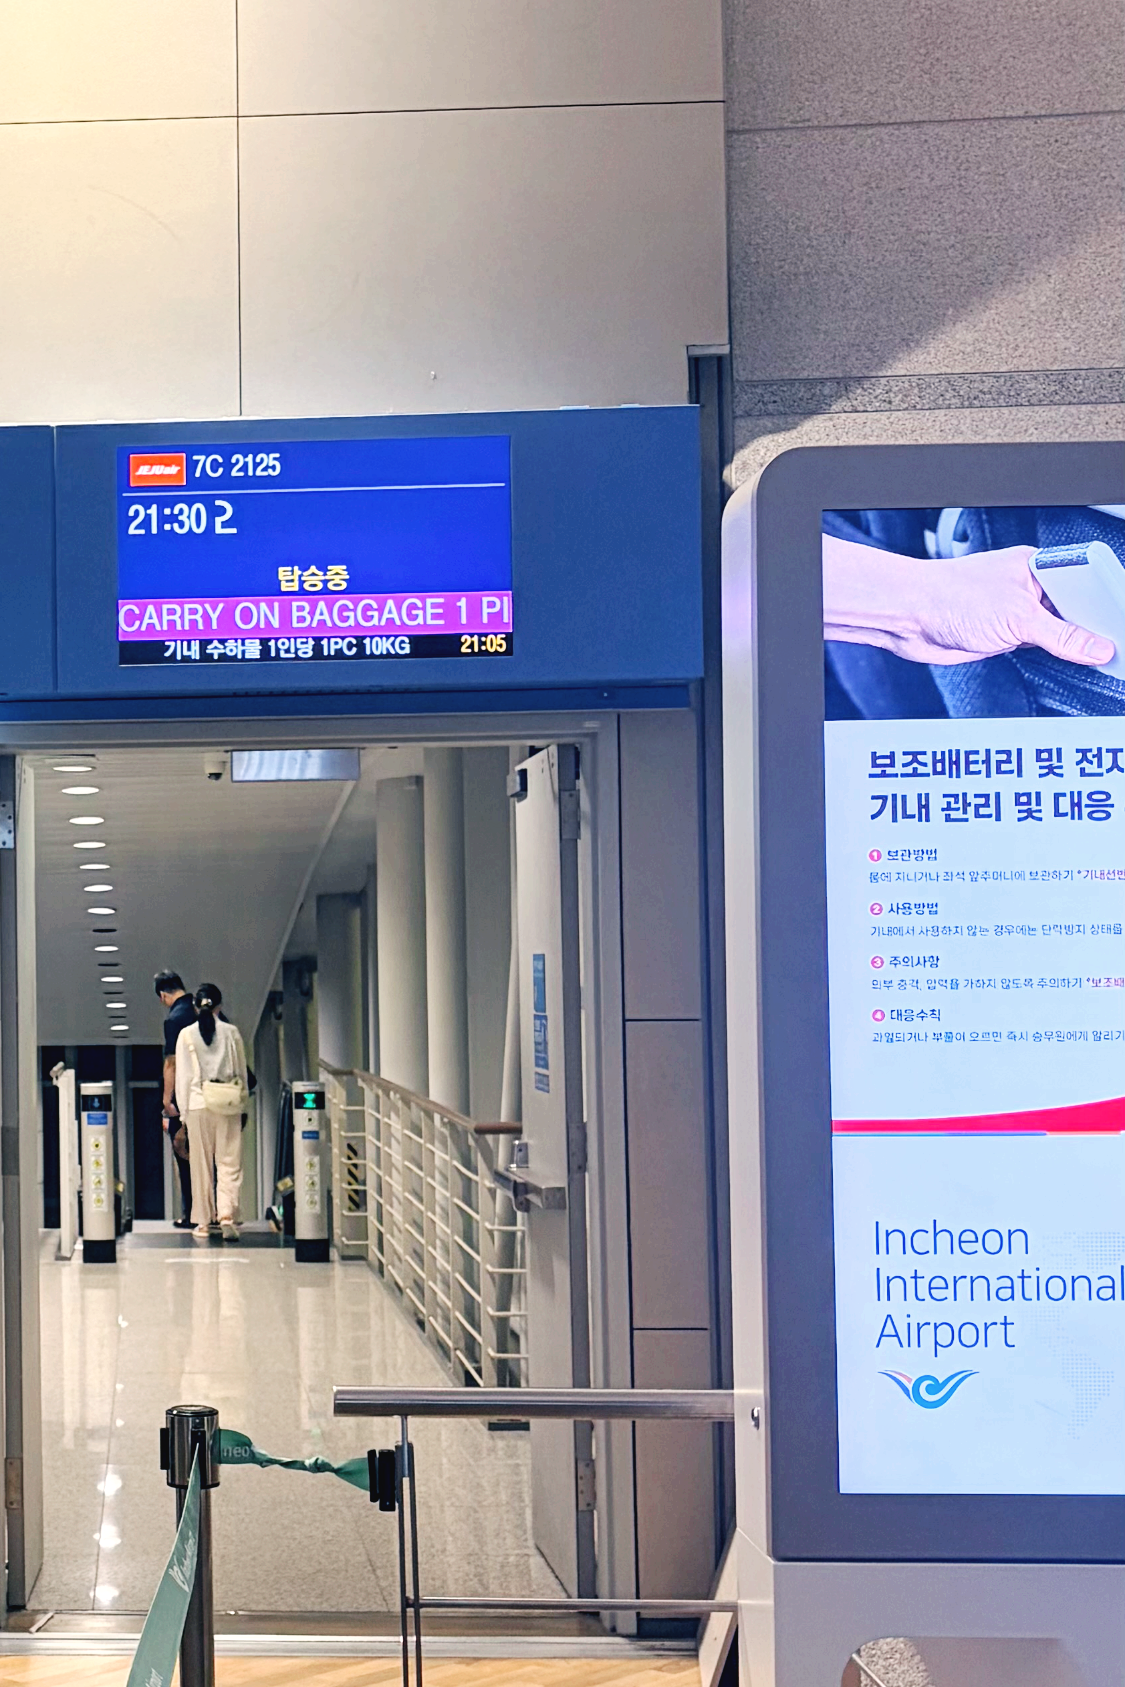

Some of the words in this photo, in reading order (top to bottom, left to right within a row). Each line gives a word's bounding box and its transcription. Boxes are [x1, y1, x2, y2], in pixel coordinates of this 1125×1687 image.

[192, 454, 224, 478] 7C
[230, 453, 281, 477] 2125
[128, 502, 207, 535] 21:30
[277, 565, 350, 592] 탑승중
[119, 603, 224, 632] CARRY
[234, 602, 280, 630] ON
[291, 597, 445, 628] BAGGAGE
[456, 597, 467, 625] 1
[163, 639, 200, 660] 기내
[205, 638, 262, 660] 수하물
[268, 637, 315, 658] 1인당
[321, 637, 357, 656] 1PC
[363, 636, 411, 656] 10KG
[460, 634, 507, 653] 21:05
[868, 748, 1023, 779] 보조배터리
[1035, 747, 1064, 779] 및
[870, 792, 930, 823] 기내
[940, 791, 1002, 823] 관리
[1014, 791, 1043, 823] 및
[1053, 790, 1115, 822] 대응
[887, 848, 937, 861] 보관방법
[895, 871, 940, 882] 지니거나
[1029, 869, 1074, 881] 보관하기
[888, 902, 938, 915] 사용방법
[871, 926, 915, 937] 기내에서
[918, 925, 963, 937] 사용하지
[993, 924, 1037, 936] 경우에는
[889, 955, 940, 968] 주의사항
[964, 978, 996, 989] 가하지
[1037, 978, 1082, 989] 주의하기
[891, 1009, 941, 1022] 대응수칙
[1033, 1031, 1088, 1042] 승무원에게
[875, 1219, 1029, 1255] Incheon
[876, 1265, 1125, 1301] International
[875, 1314, 1016, 1358] Airport
